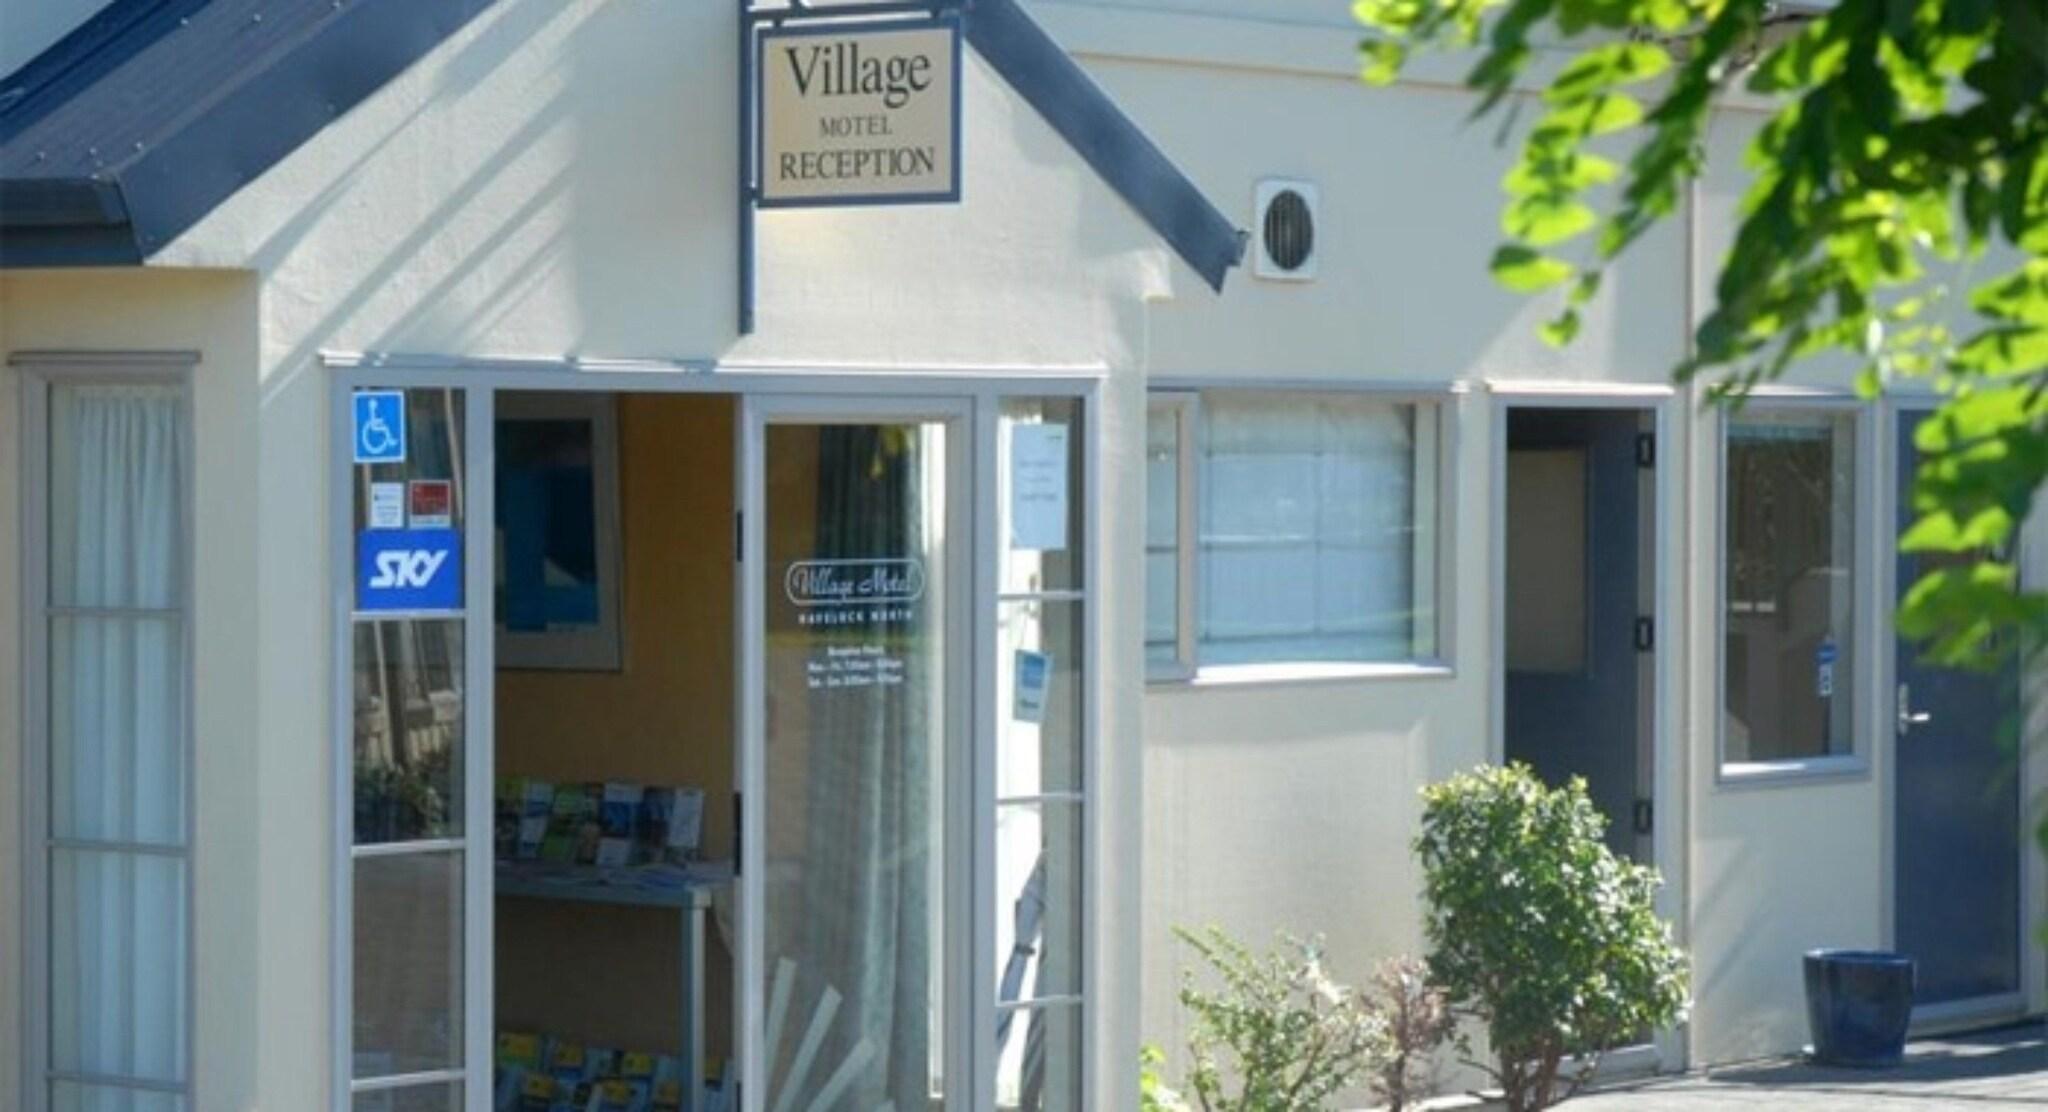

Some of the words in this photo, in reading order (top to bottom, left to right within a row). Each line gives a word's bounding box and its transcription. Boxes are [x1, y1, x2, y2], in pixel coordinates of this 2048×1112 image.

[785, 42, 932, 109] Village
[820, 115, 893, 138] MOTEL
[780, 147, 935, 181] RECEPTION
[369, 550, 448, 589] SKY
[792, 567, 855, 602] Village
[858, 566, 912, 592] Motel
[798, 611, 863, 624] HAVELOCK
[871, 609, 912, 621] NORTH
